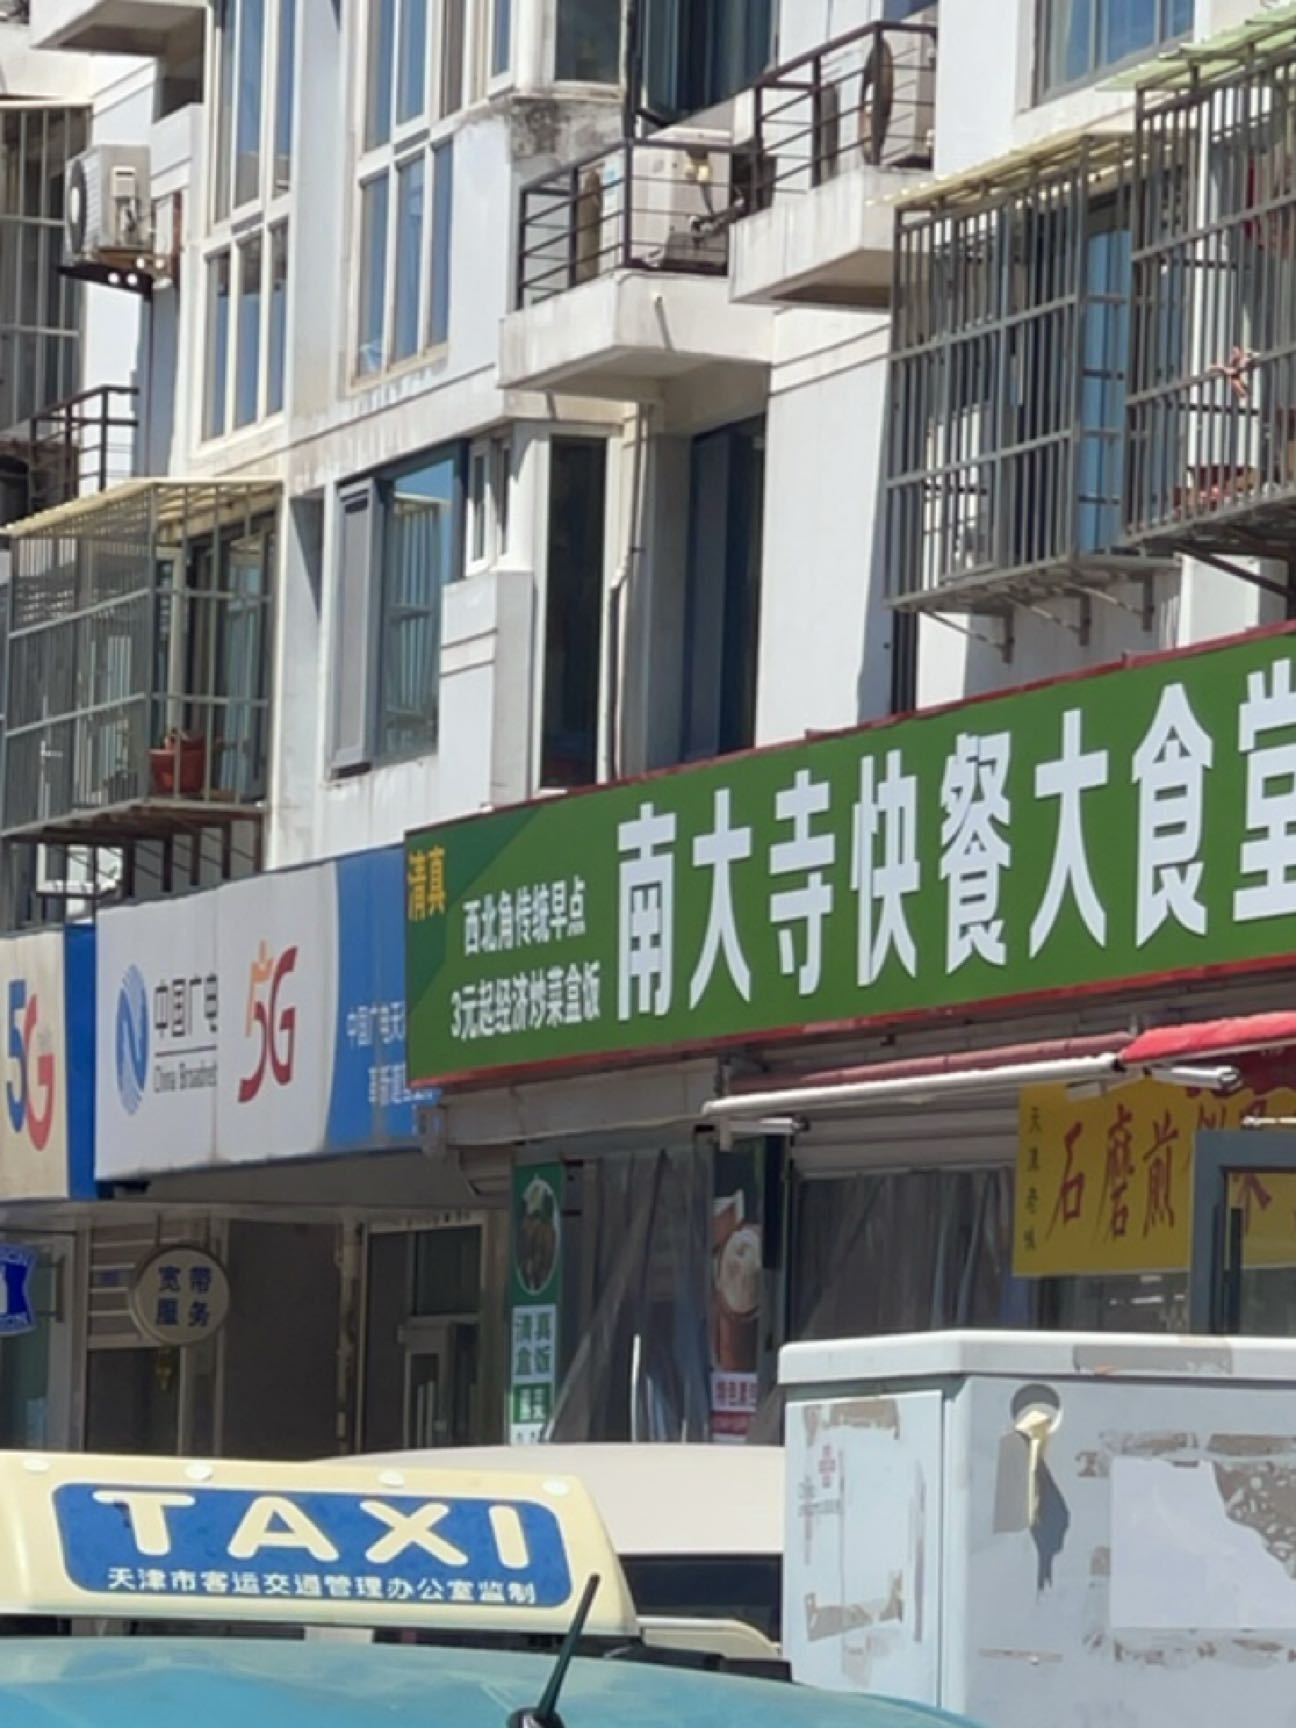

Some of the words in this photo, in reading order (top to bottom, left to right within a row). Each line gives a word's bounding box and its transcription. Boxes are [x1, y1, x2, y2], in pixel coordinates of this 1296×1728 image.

[408, 844, 446, 922] 清真
[462, 874, 586, 956] 西北角传统早点
[155, 974, 217, 1038] 中国广电
[238, 938, 297, 1104] 5G
[450, 960, 601, 1041] 3元起经济炒菜盒饭
[7, 979, 53, 1151] 5G
[93, 1490, 531, 1570] TAXI
[107, 1566, 536, 1605] 天津市客运交通管理办公室监制
